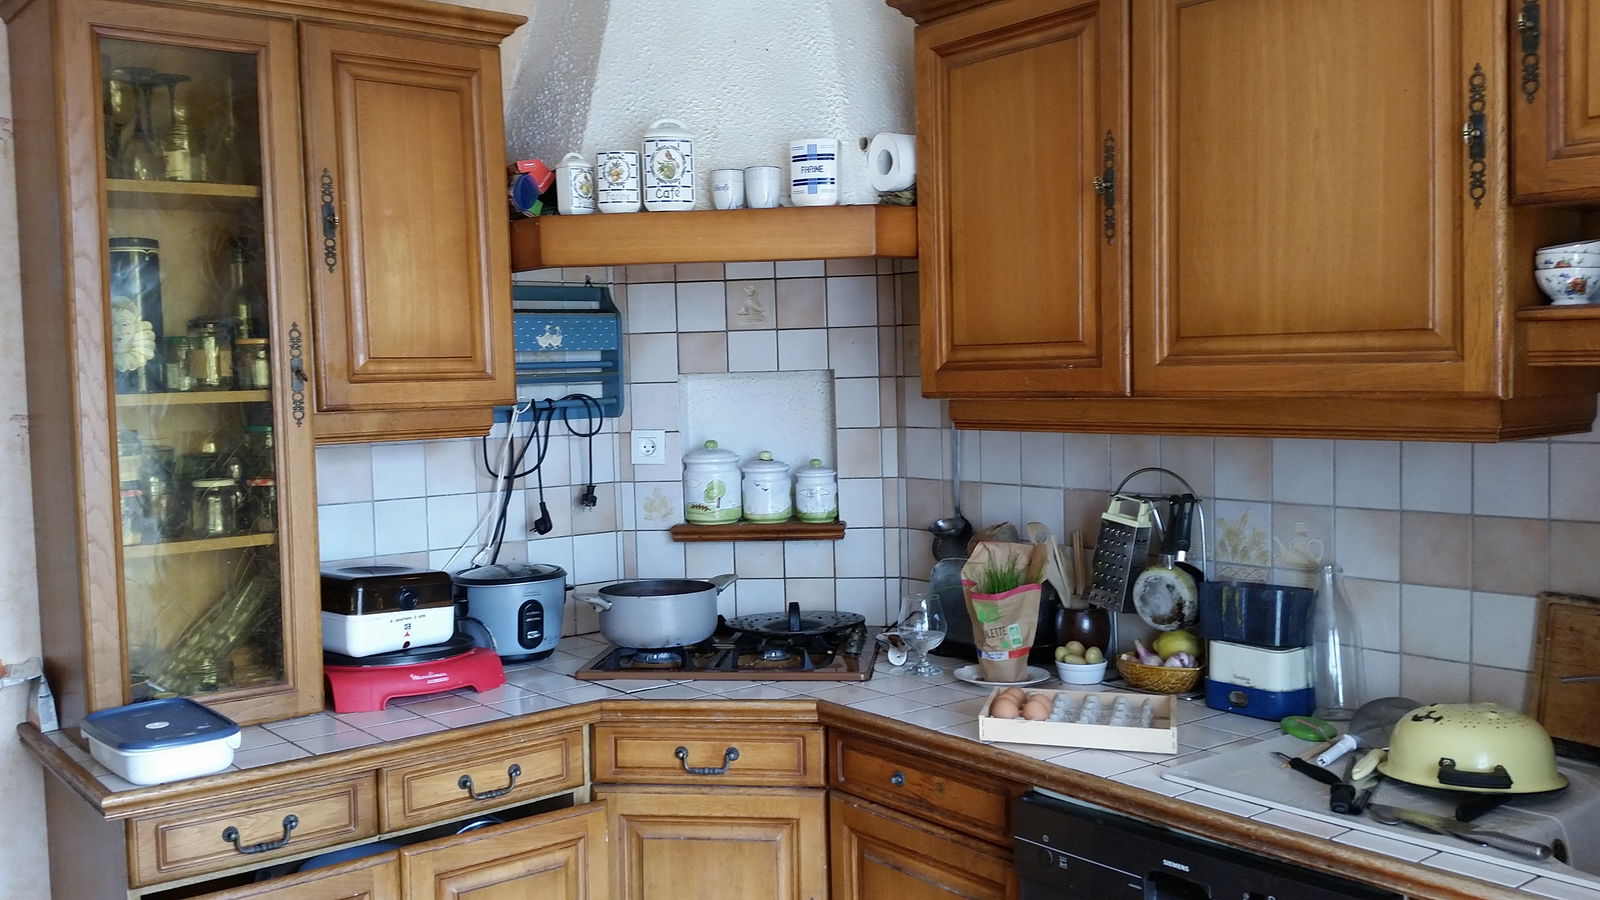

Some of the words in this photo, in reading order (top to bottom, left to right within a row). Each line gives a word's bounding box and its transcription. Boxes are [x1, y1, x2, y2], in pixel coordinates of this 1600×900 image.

[801, 165, 824, 173] FARINE
[656, 187, 680, 199] Café
[984, 626, 1007, 638] LETTE
[1163, 859, 1190, 872] SIEMENS
